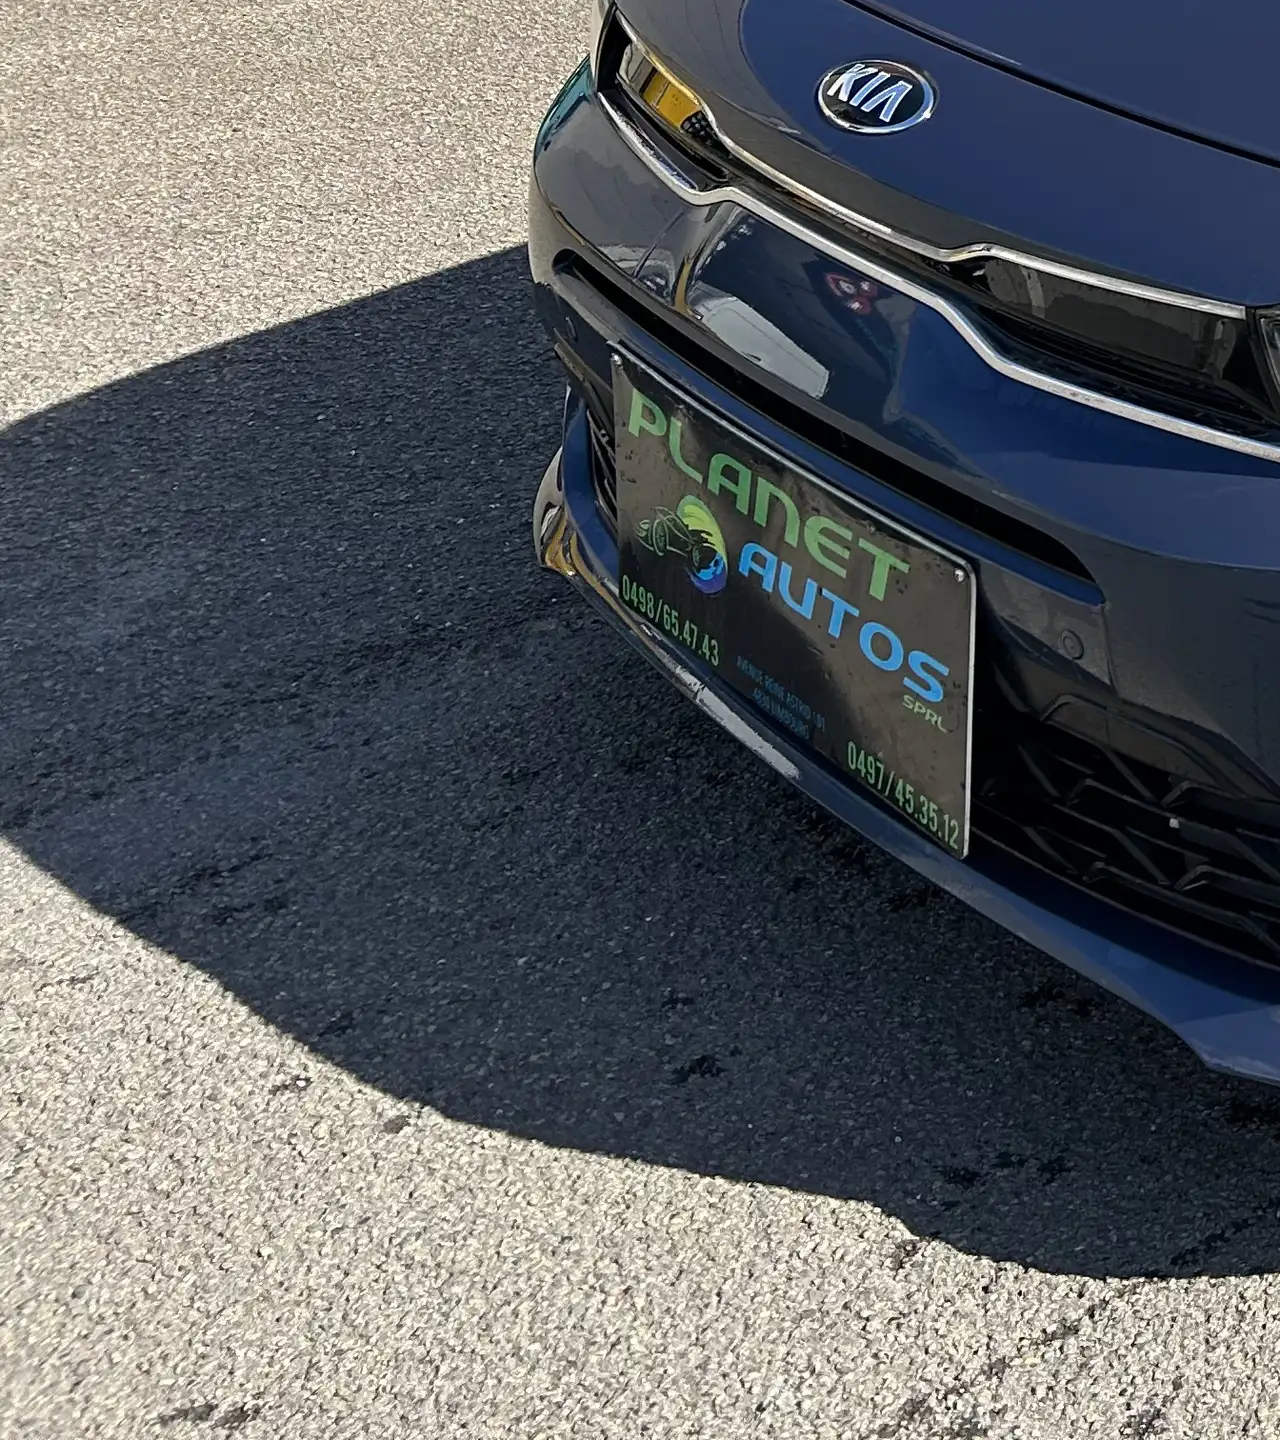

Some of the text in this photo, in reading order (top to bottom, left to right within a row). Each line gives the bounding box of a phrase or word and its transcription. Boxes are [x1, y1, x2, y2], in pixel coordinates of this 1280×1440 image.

[826, 63, 913, 123] KIA
[628, 387, 911, 603] PLANET
[621, 573, 721, 667] 0498/65.47.43
[738, 541, 950, 704] AUTOS
[902, 693, 949, 735] SPRL
[846, 740, 960, 851] 0497/45.35.12
